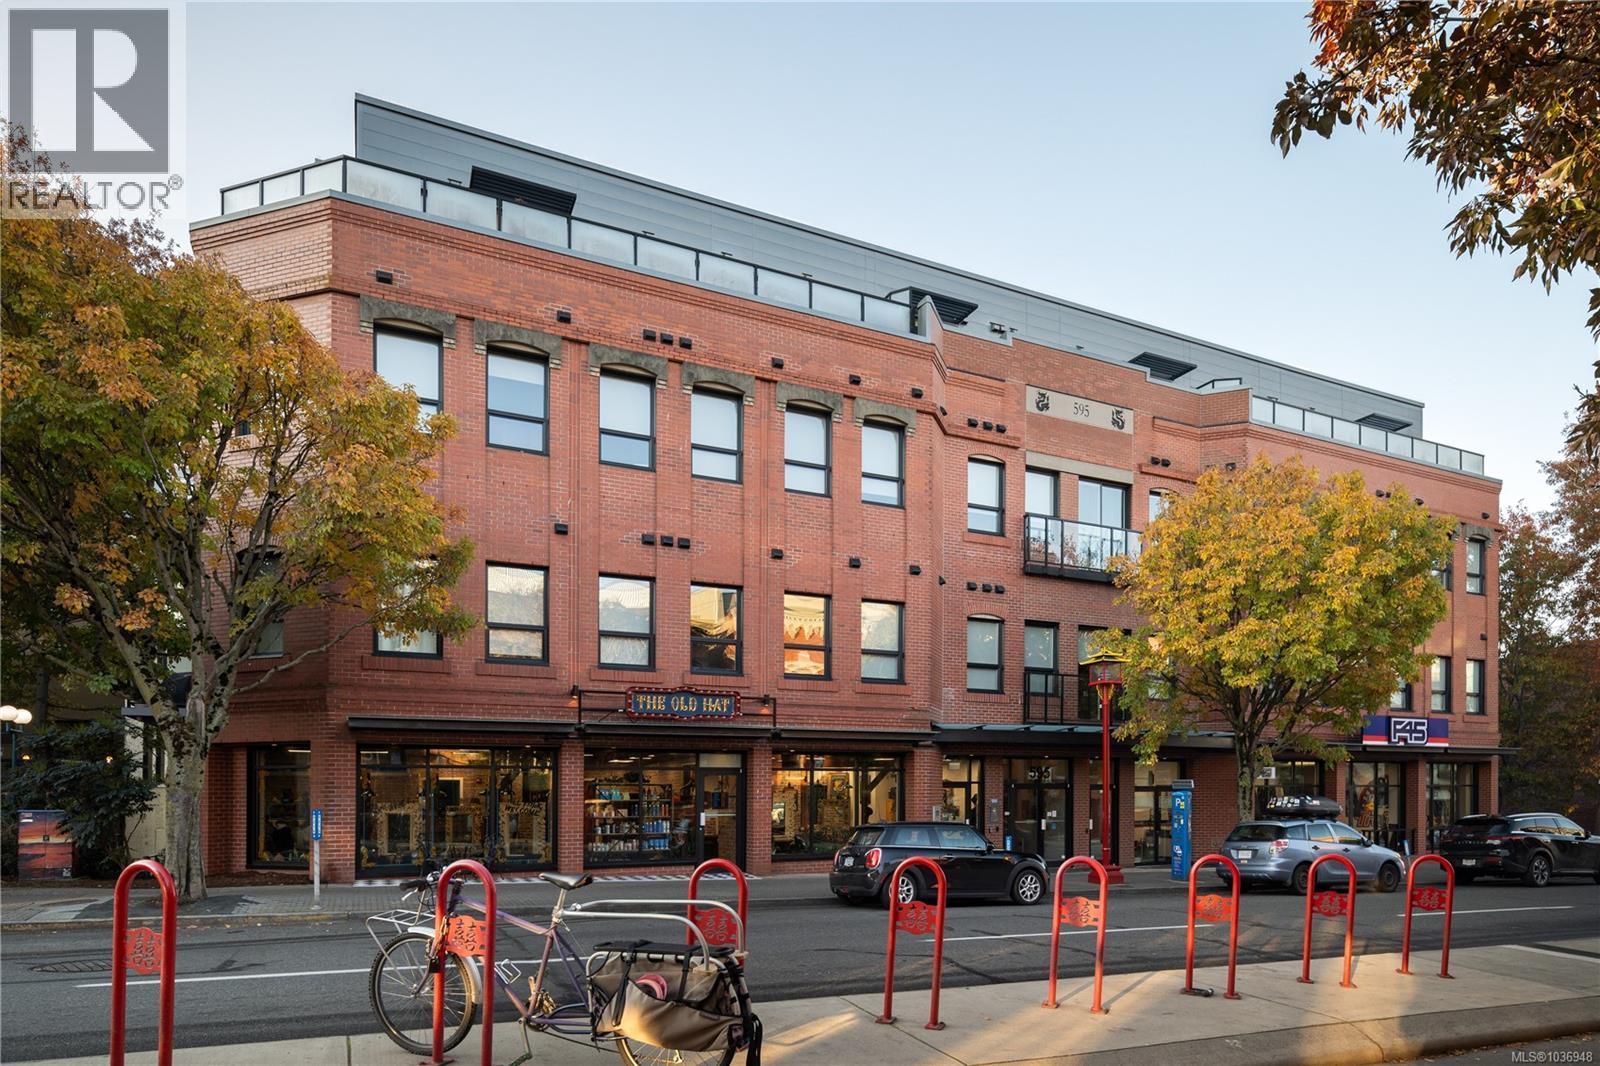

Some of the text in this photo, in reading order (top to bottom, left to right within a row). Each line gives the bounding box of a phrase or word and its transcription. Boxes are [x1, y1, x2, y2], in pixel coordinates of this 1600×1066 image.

[1073, 402, 1090, 418] 595
[636, 694, 730, 713] THE OLD HAT
[1391, 717, 1428, 744] F45
